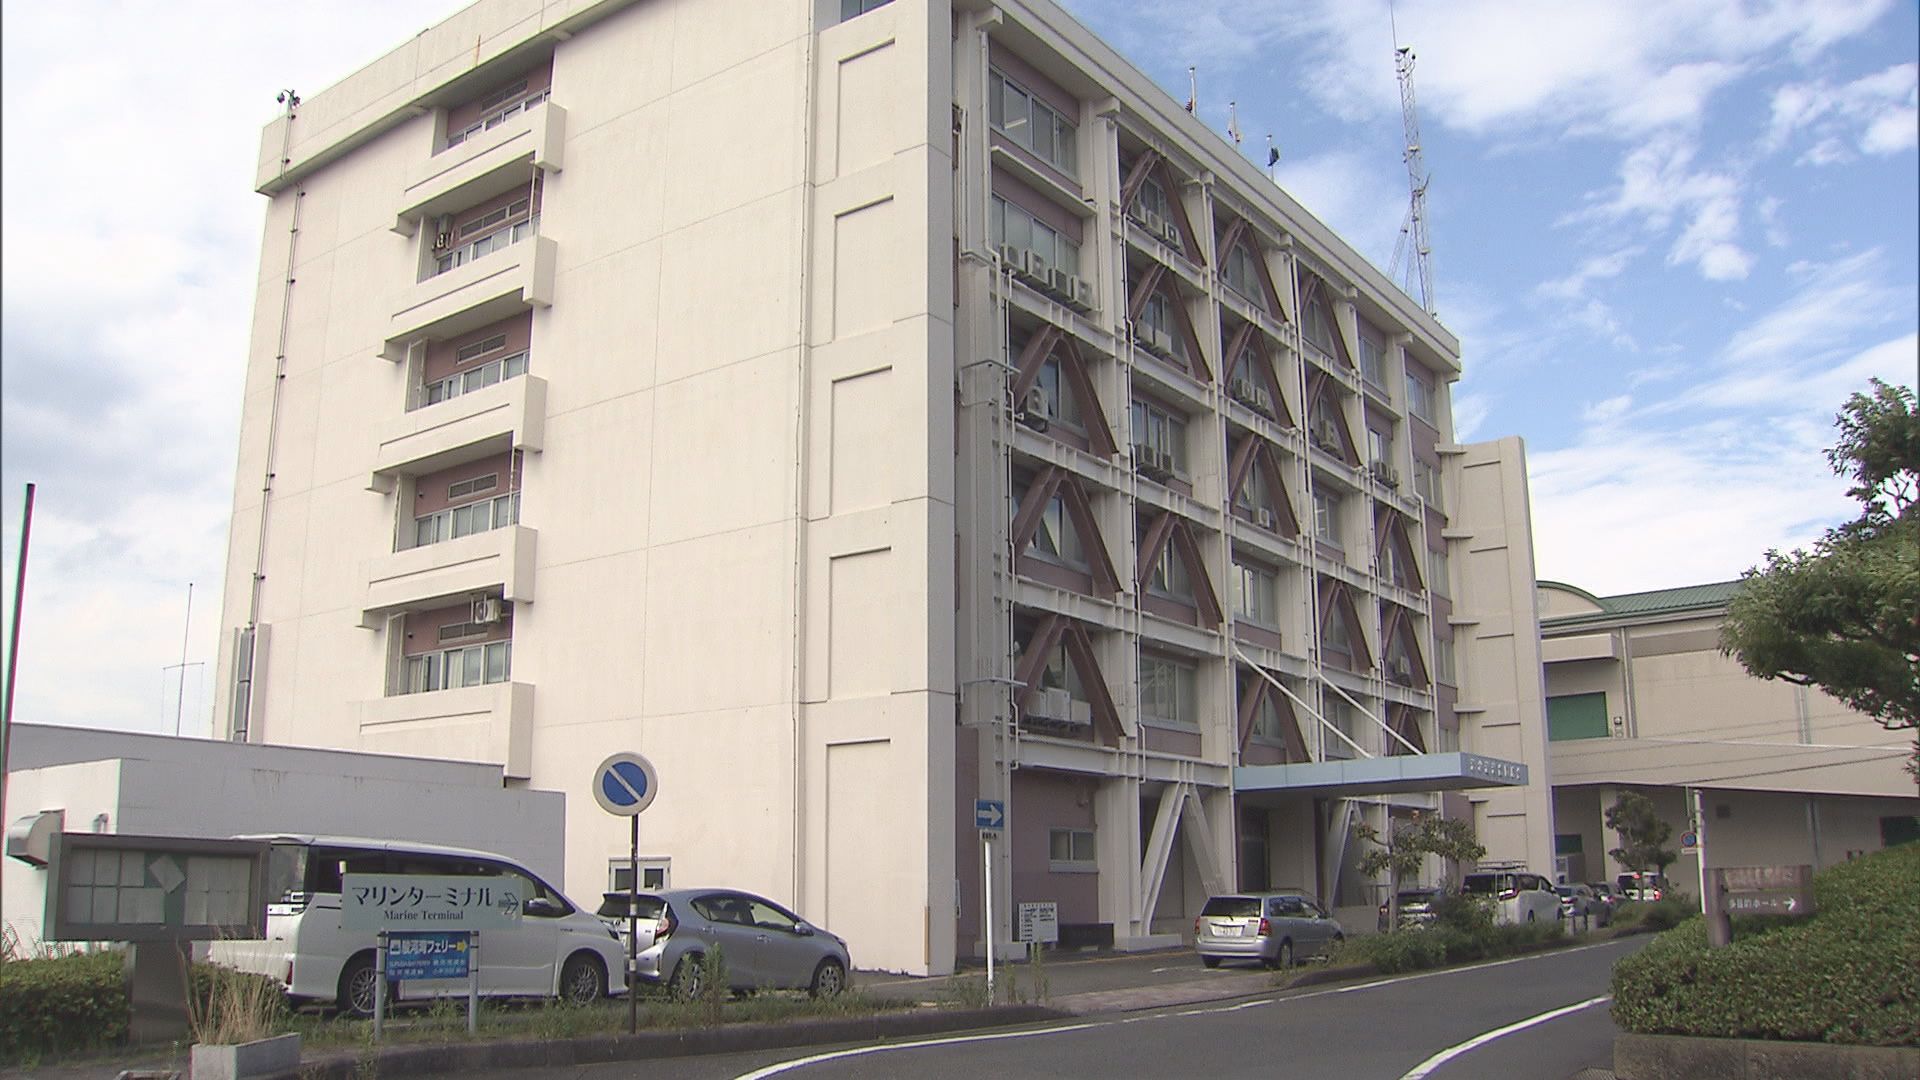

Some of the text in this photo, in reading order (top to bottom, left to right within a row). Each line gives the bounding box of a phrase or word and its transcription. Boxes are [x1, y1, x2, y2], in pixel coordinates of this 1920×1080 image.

[352, 886, 493, 907] マリンターミナル
[383, 910, 464, 921] Marine Terminal
